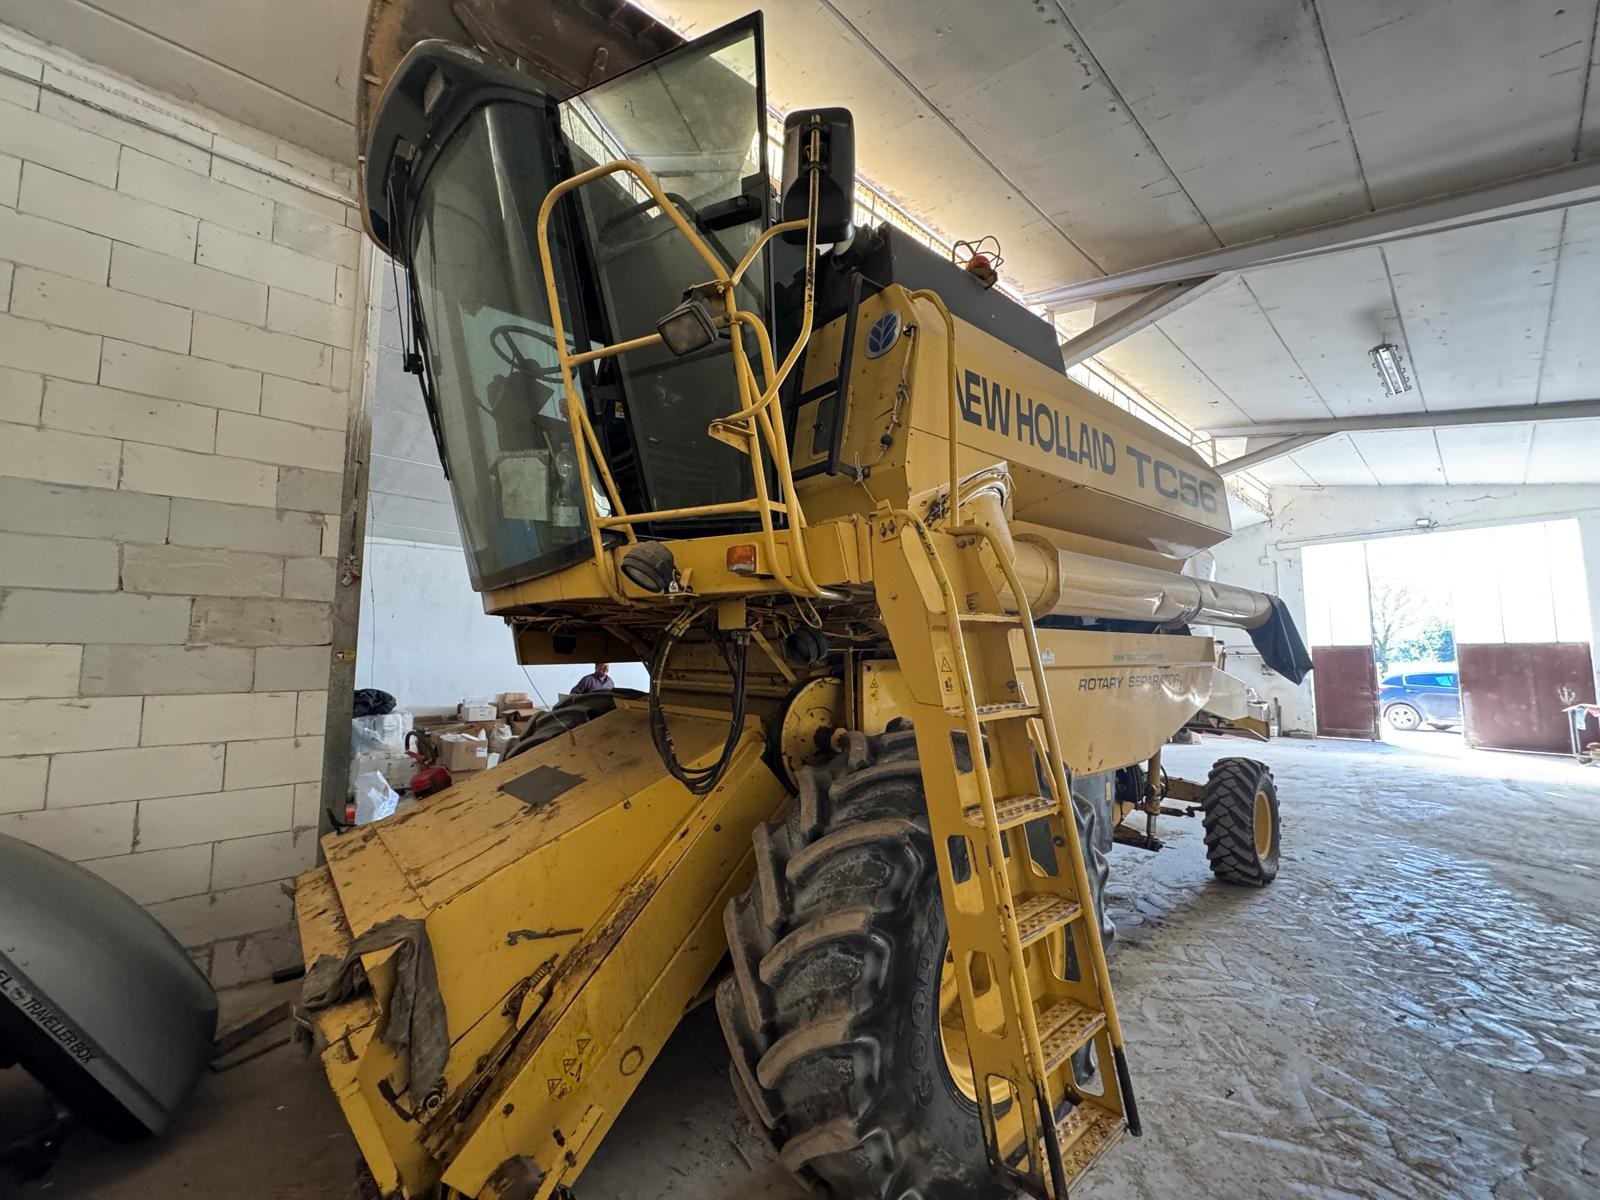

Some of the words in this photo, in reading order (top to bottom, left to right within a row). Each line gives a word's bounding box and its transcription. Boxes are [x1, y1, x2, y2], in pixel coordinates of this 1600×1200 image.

[1015, 391, 1117, 476] HOLLAND
[1126, 444, 1218, 515] TC56
[1078, 676, 1124, 692] ROTARY
